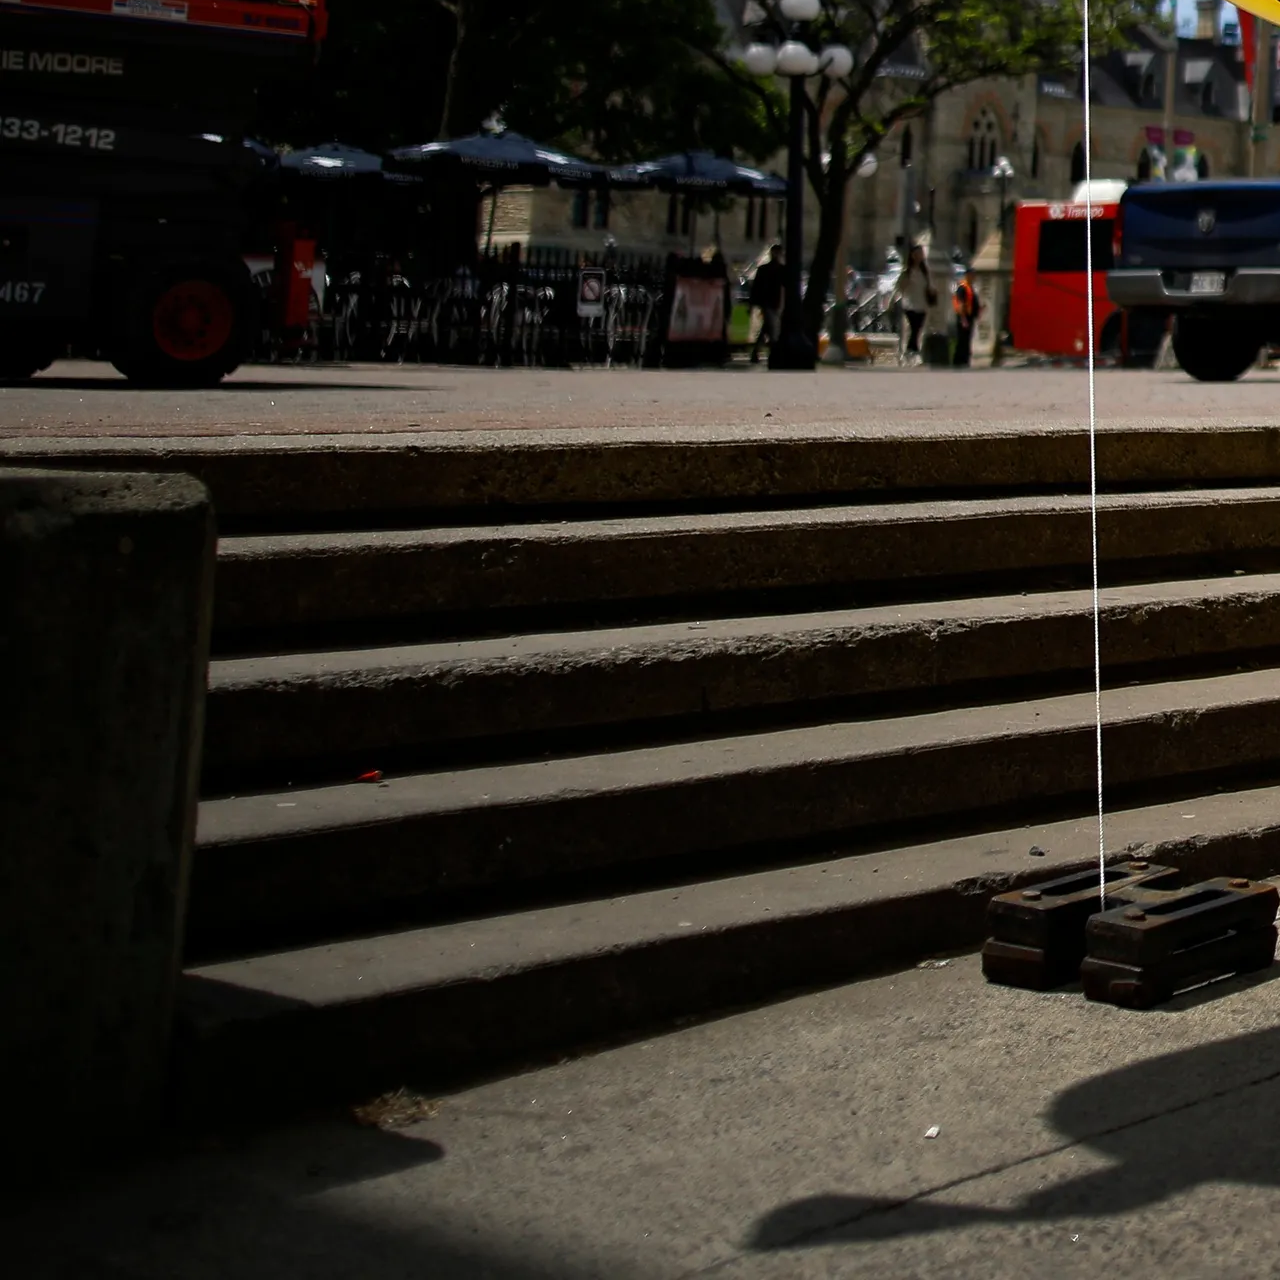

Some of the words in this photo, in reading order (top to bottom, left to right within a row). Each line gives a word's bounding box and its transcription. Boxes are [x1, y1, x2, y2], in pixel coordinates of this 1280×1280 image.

[0, 49, 25, 71] IE
[27, 51, 125, 76] MOORE
[0, 115, 116, 151] 33-1212
